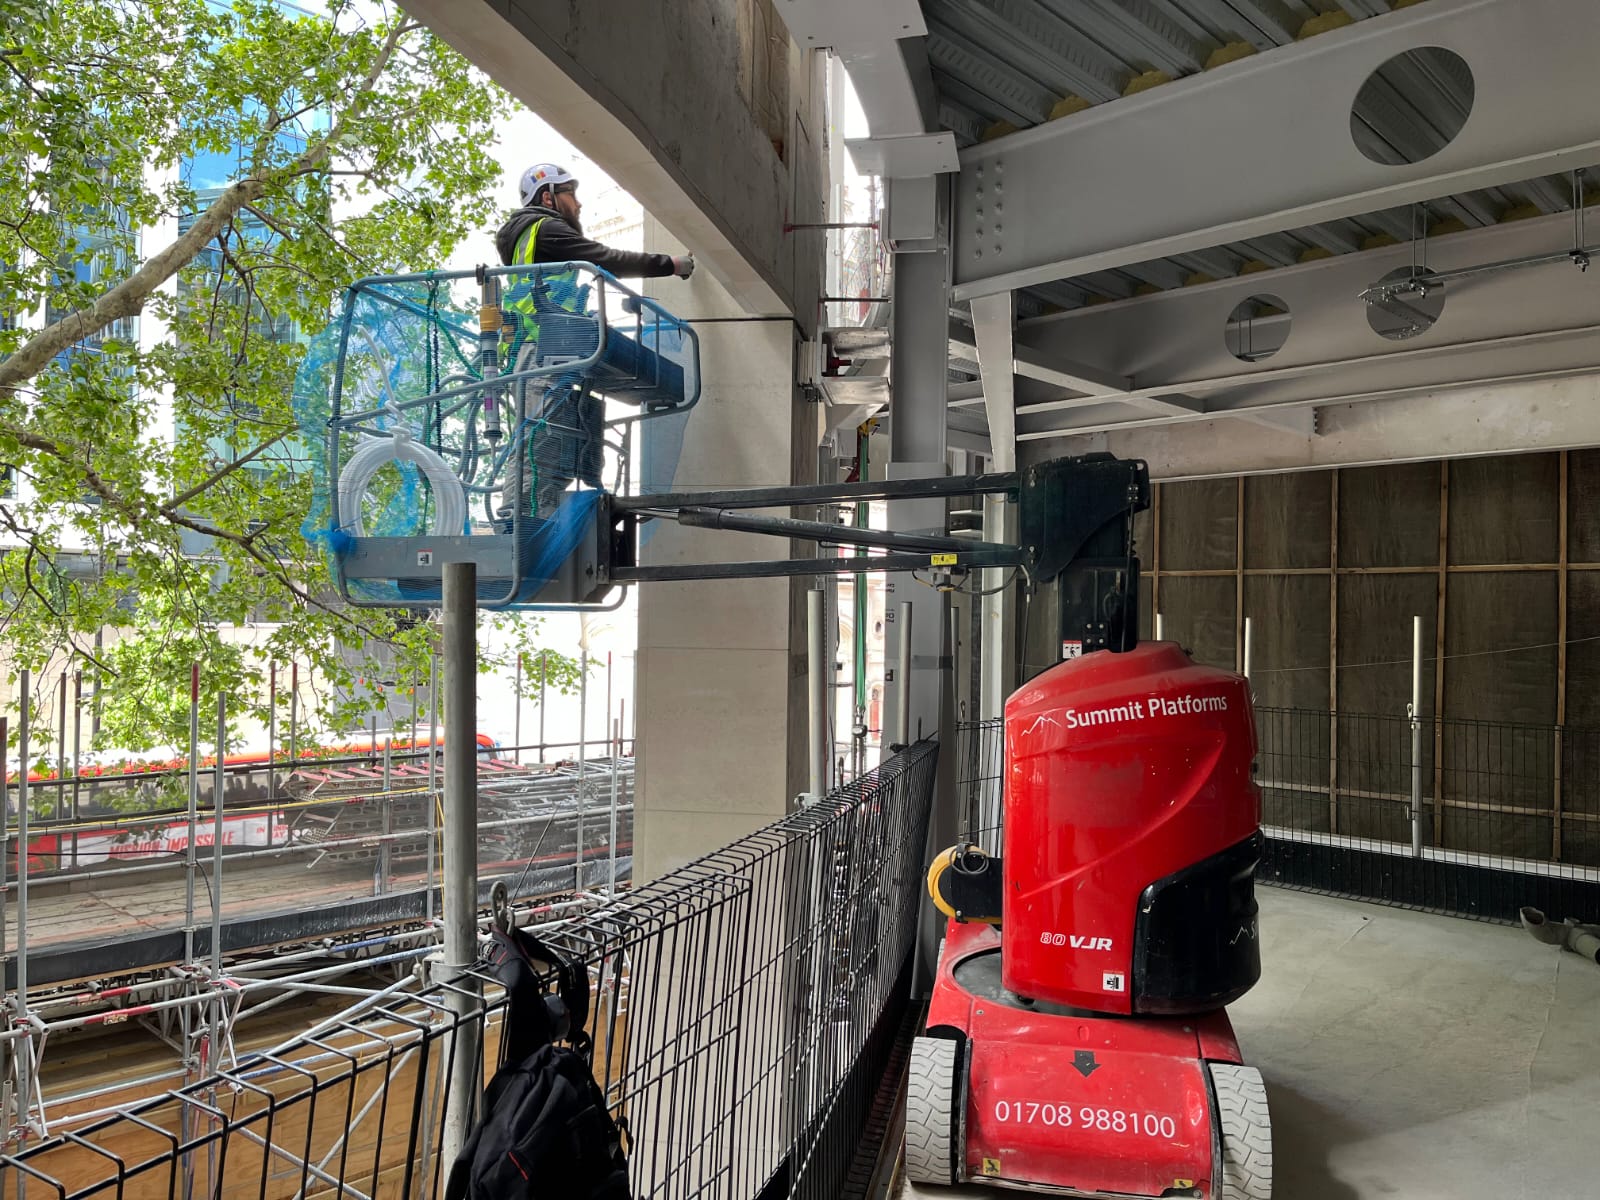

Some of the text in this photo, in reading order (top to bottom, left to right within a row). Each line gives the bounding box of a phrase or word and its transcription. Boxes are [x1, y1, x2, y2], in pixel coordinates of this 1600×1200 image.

[1065, 695, 1227, 729] Summit Platforms
[1040, 932, 1113, 951] 80 VJR
[995, 1101, 1175, 1138] 01708 988100
